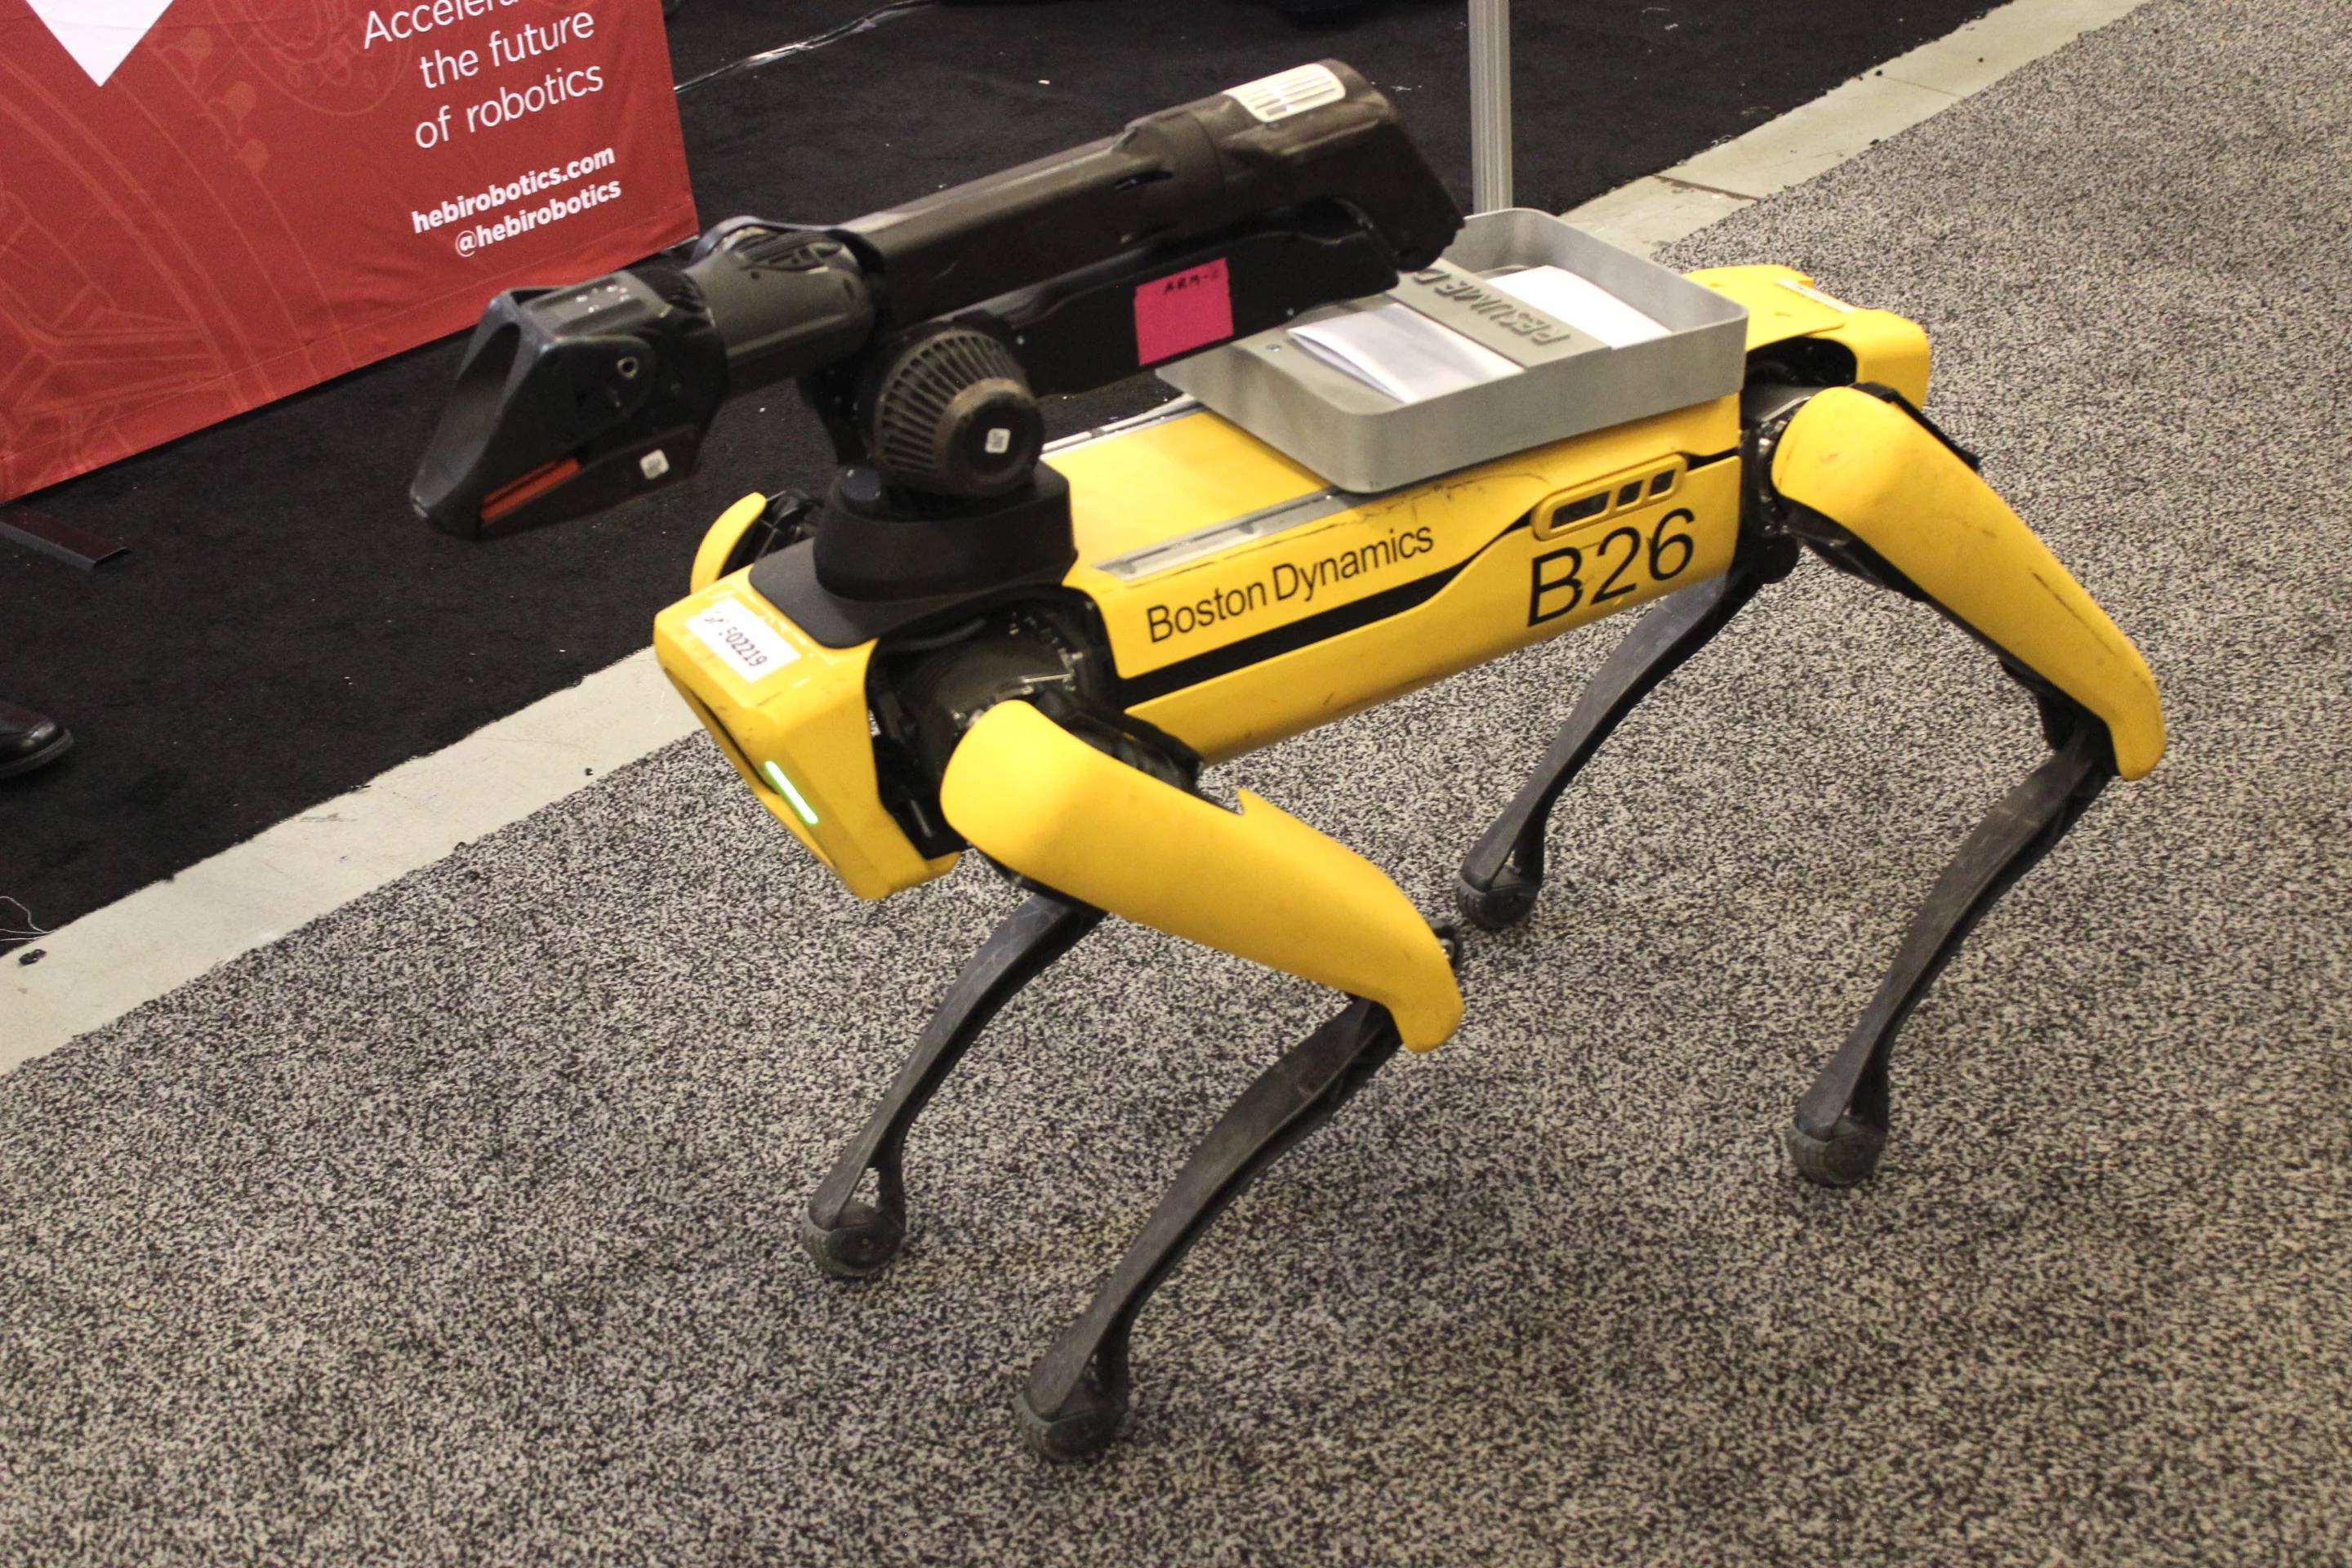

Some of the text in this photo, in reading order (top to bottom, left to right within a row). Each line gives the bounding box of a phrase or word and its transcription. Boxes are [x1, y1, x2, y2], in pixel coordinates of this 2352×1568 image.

[363, 0, 519, 50] Accele
[419, 10, 595, 89] the future
[415, 65, 604, 149] of robotics
[412, 147, 616, 234] hebirobotics.com
[455, 179, 621, 257] @hebirobotics
[1146, 523, 1435, 644] Boston Dynamics
[1526, 506, 1696, 629] B26
